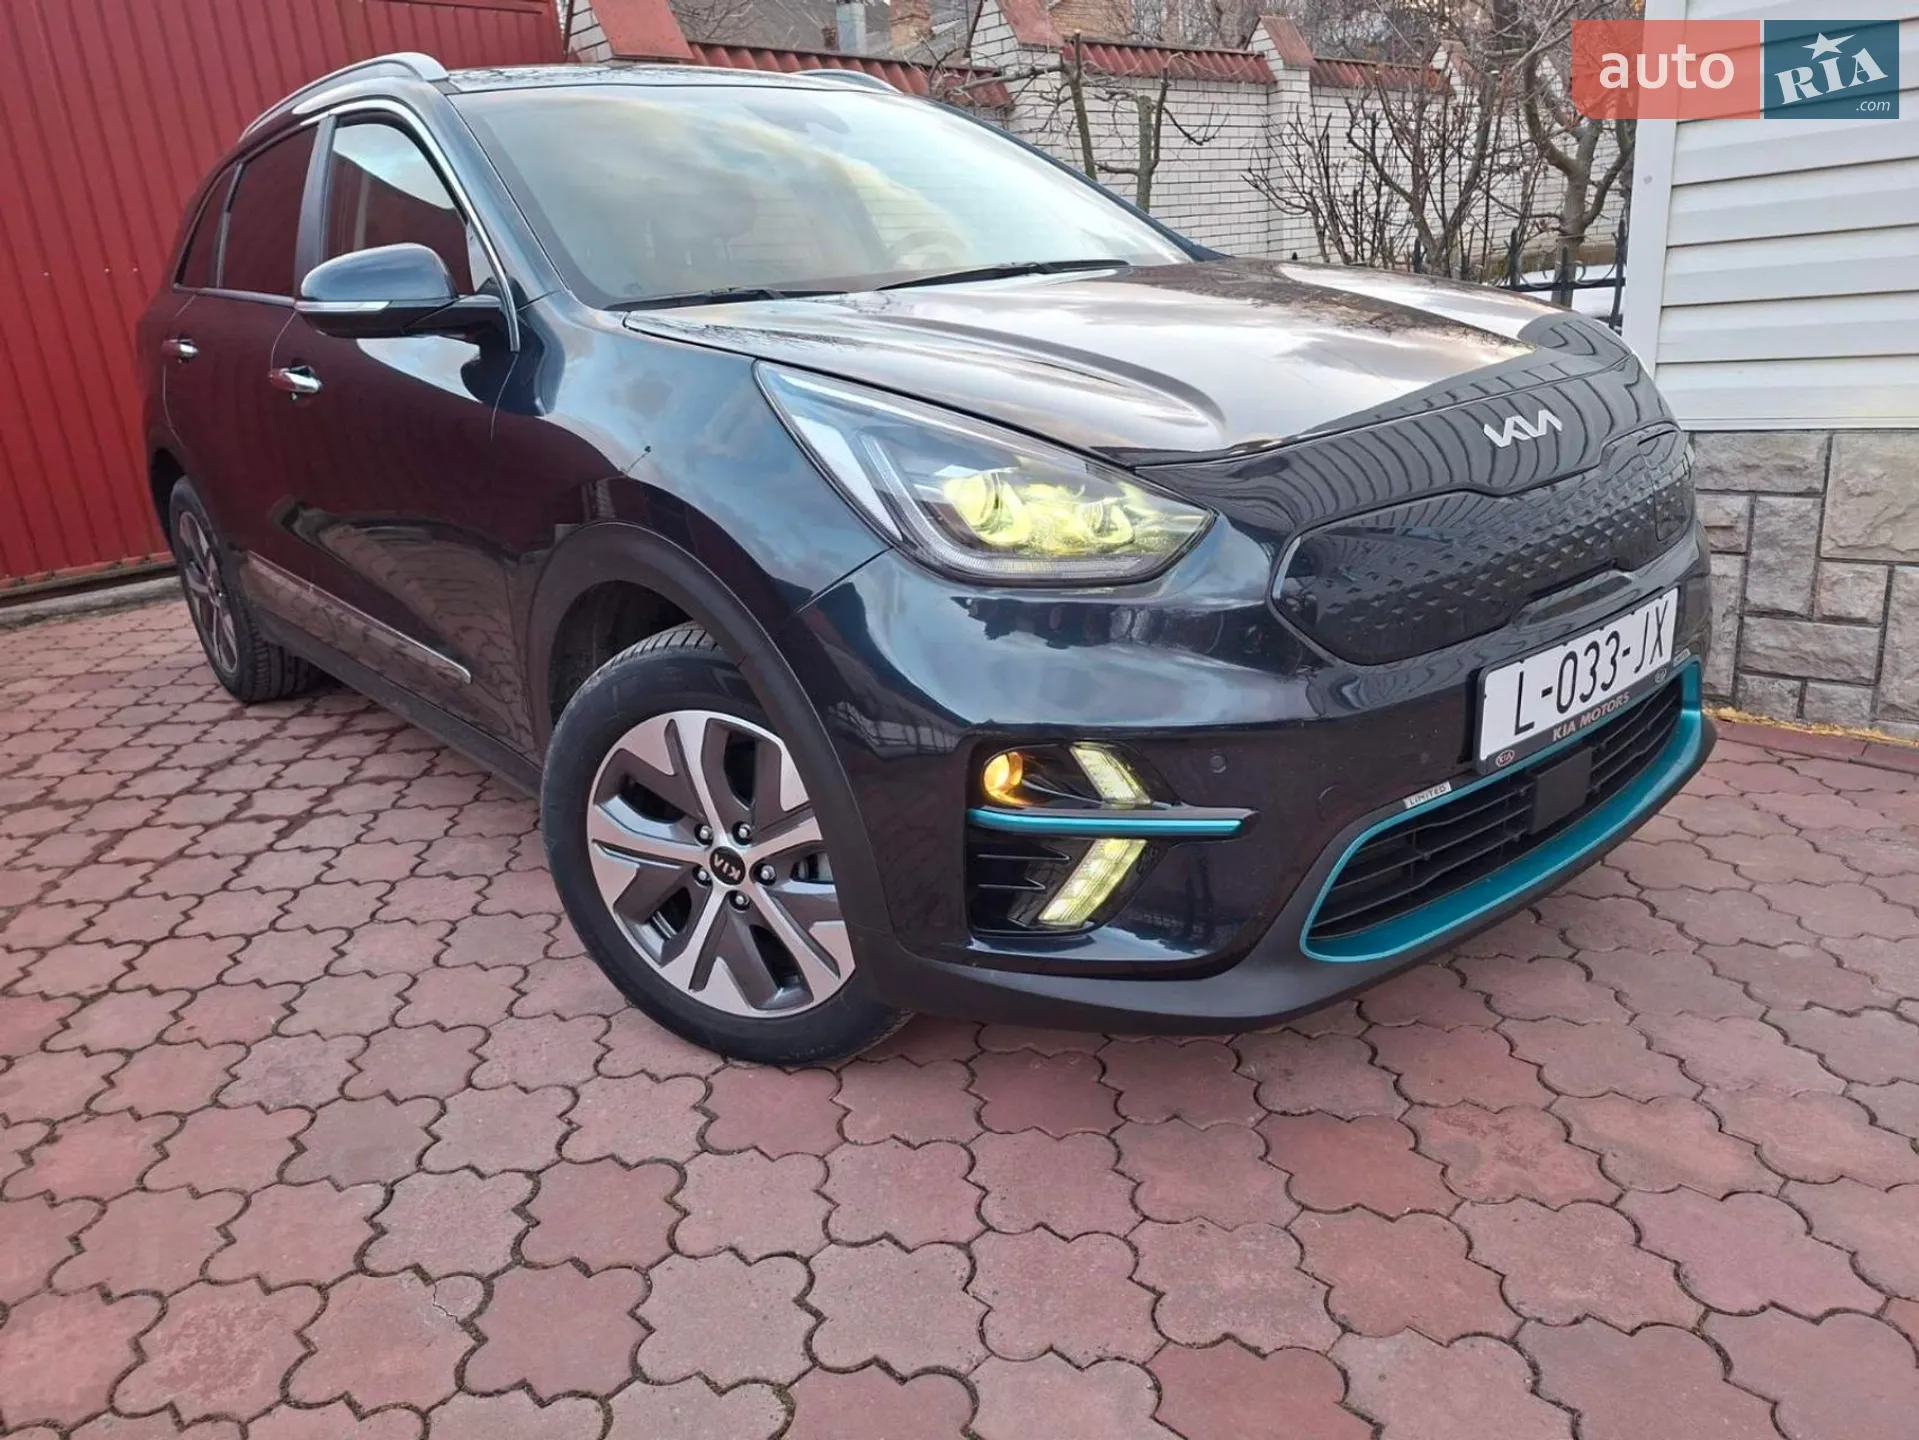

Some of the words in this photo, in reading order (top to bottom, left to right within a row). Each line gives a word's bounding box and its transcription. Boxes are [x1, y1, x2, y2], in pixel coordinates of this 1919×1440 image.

[1514, 600, 1669, 736] L-033-JX
[1552, 719, 1577, 742] KIA
[1579, 691, 1631, 726] MOTORS
[714, 853, 741, 880] KIA
